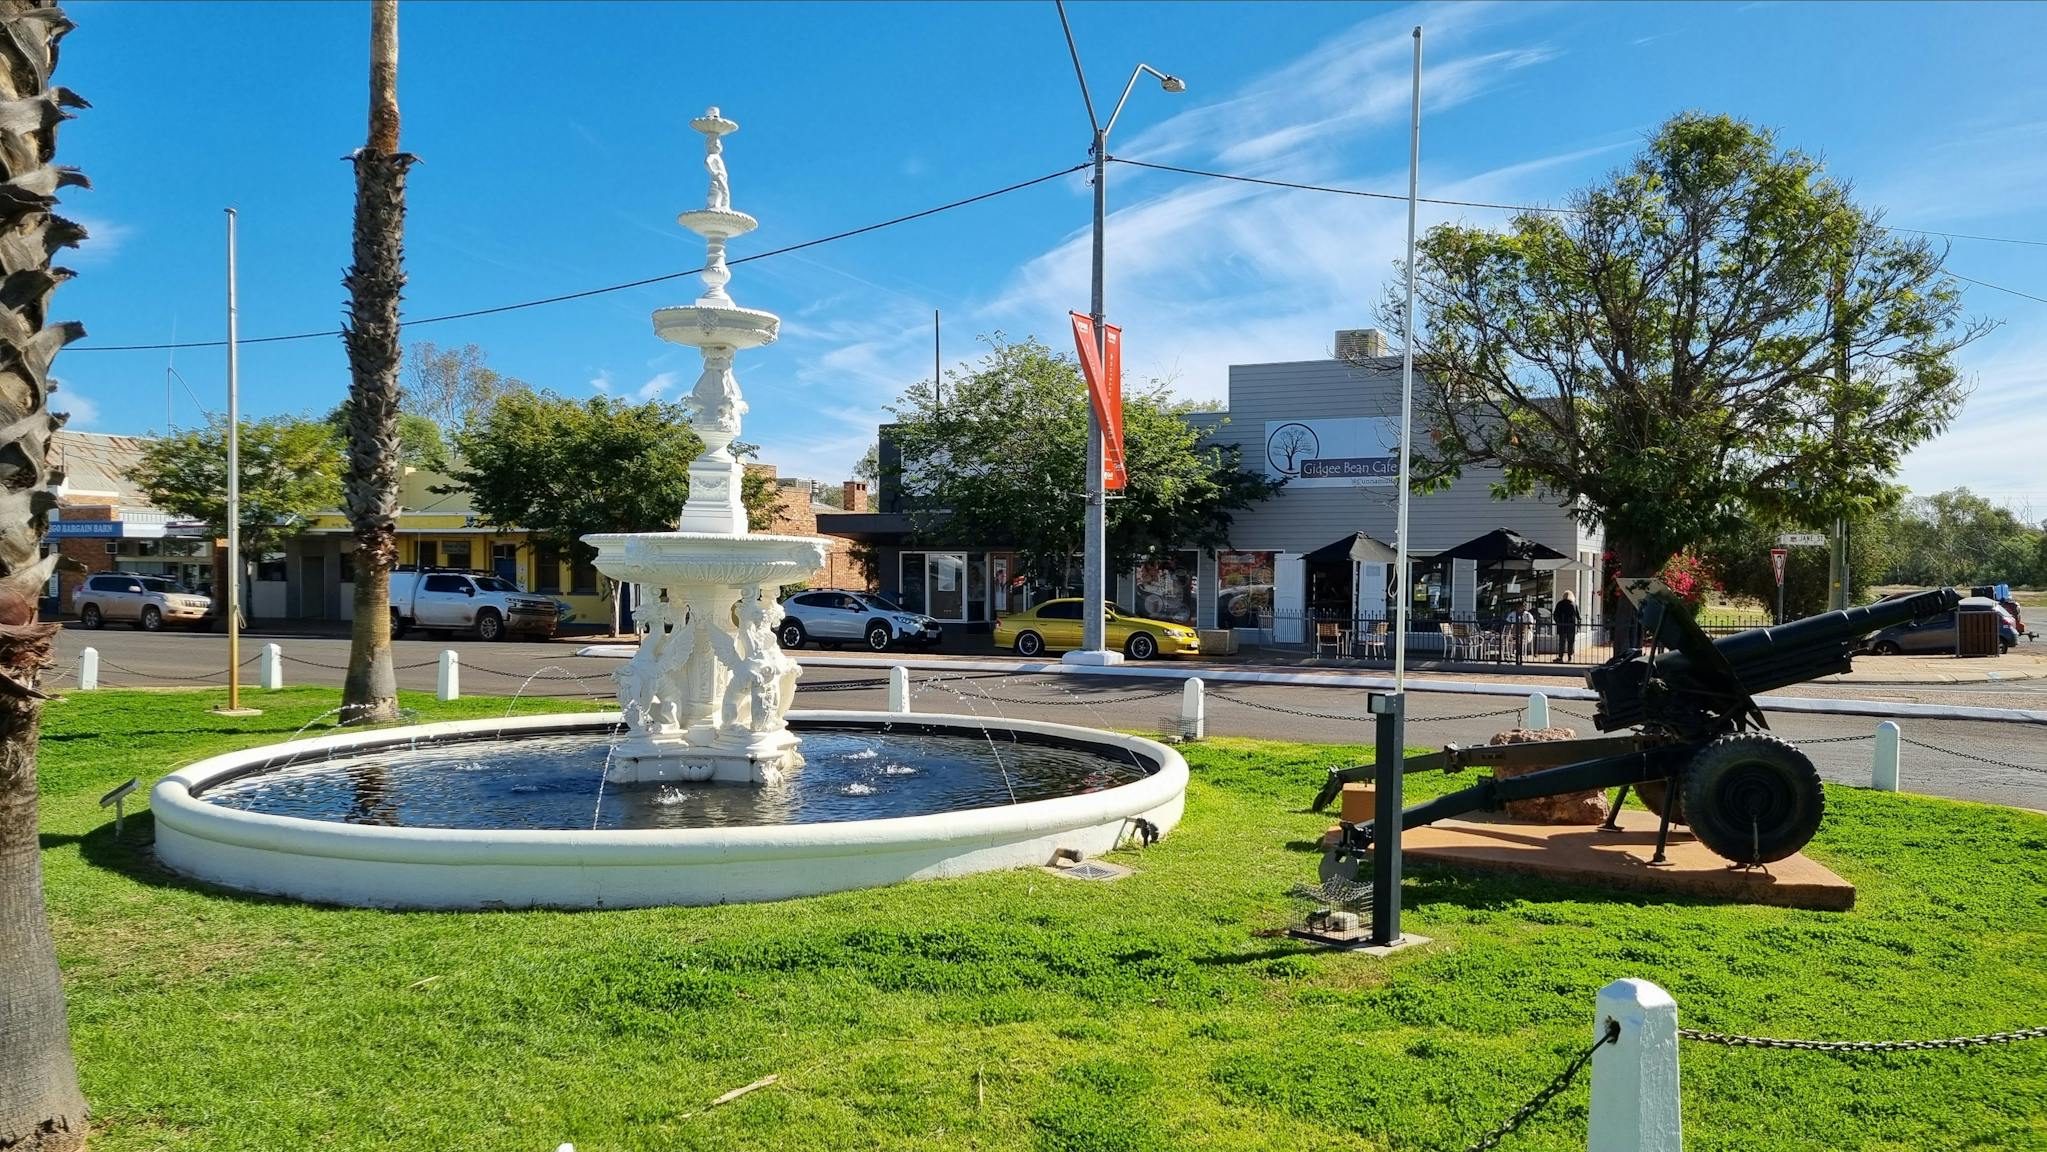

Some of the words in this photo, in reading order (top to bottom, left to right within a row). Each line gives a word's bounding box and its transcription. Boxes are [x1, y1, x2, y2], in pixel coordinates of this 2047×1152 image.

[1303, 462, 1341, 477] Gidgee
[1344, 461, 1369, 474] Bean
[1372, 458, 1397, 473] Cafe
[62, 523, 93, 533] BARGAIN
[94, 523, 113, 533] BARN
